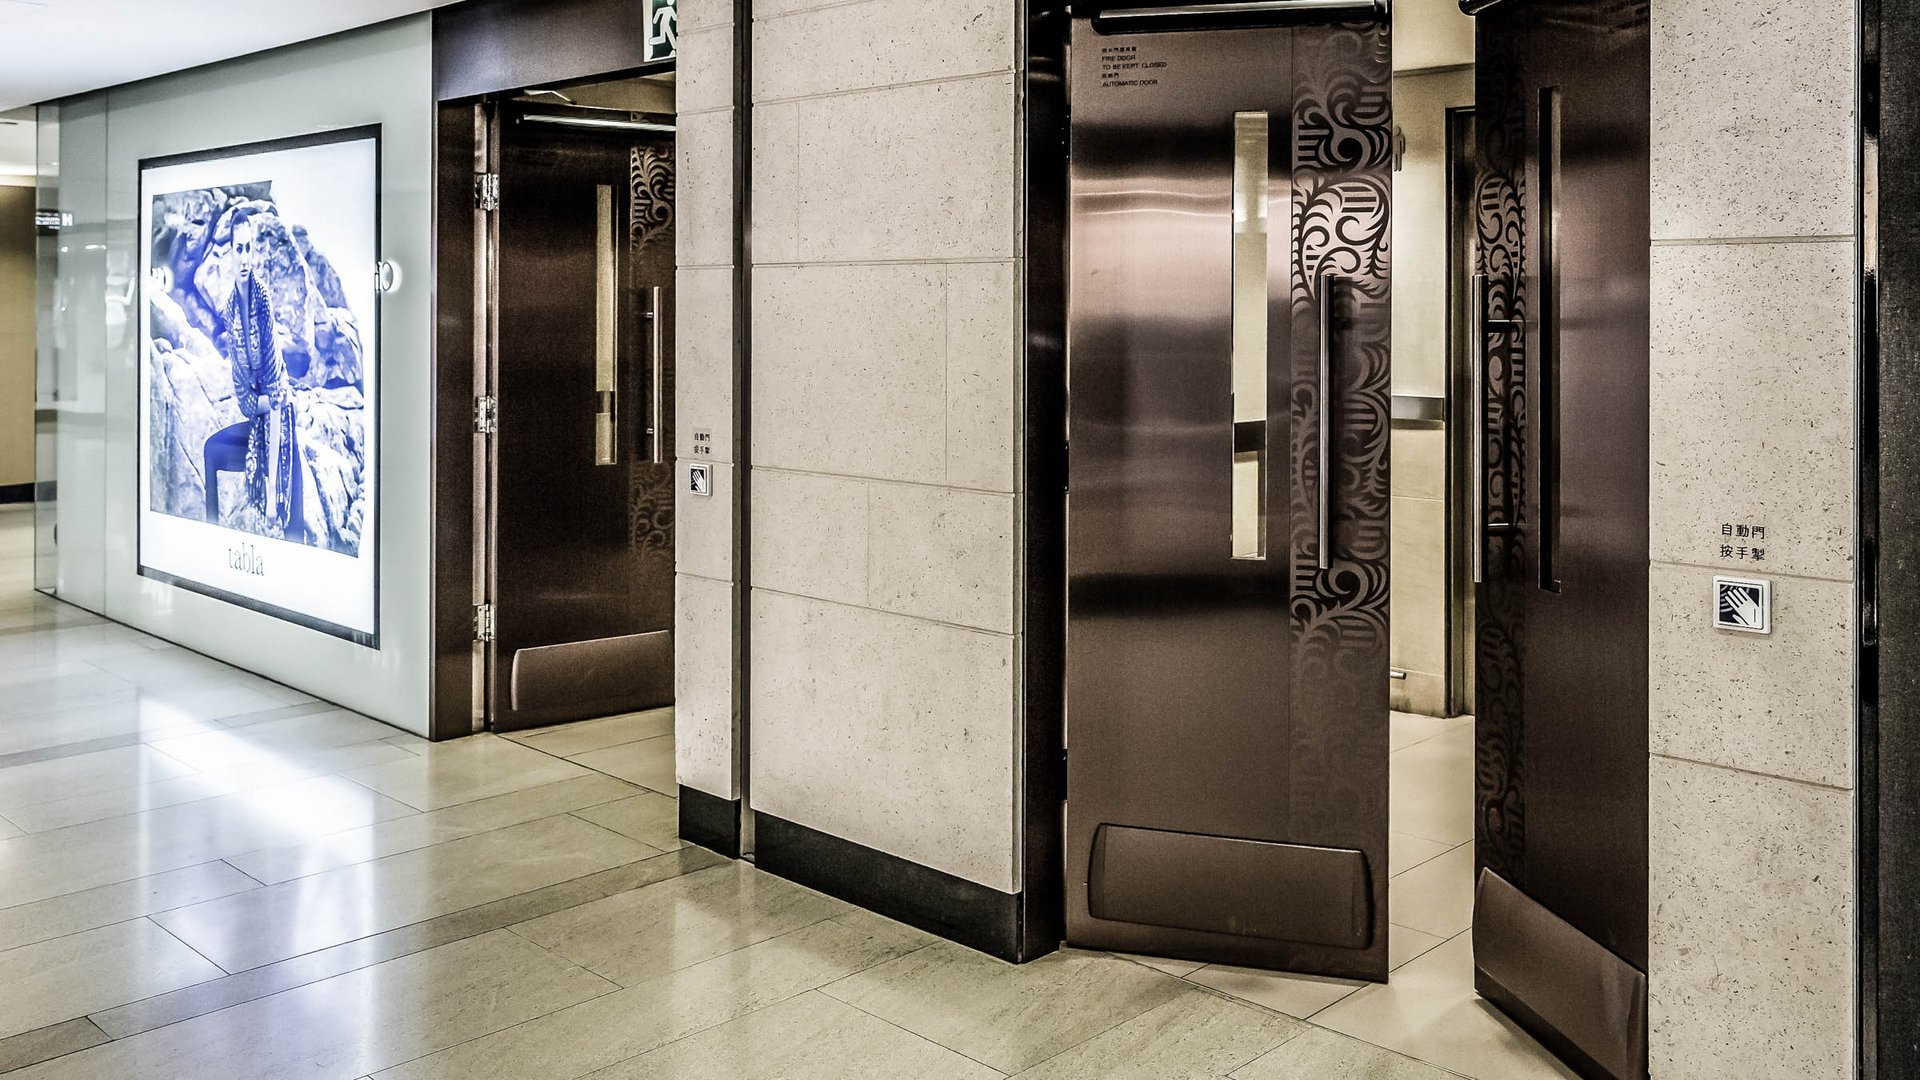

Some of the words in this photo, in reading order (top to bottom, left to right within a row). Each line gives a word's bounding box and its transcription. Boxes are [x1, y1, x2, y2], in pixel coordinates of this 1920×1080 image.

[1141, 61, 1167, 69] CLOSED
[1102, 80, 1138, 88] AUTOMATIC
[1721, 523, 1765, 539] 自動門
[228, 542, 264, 576] tabla
